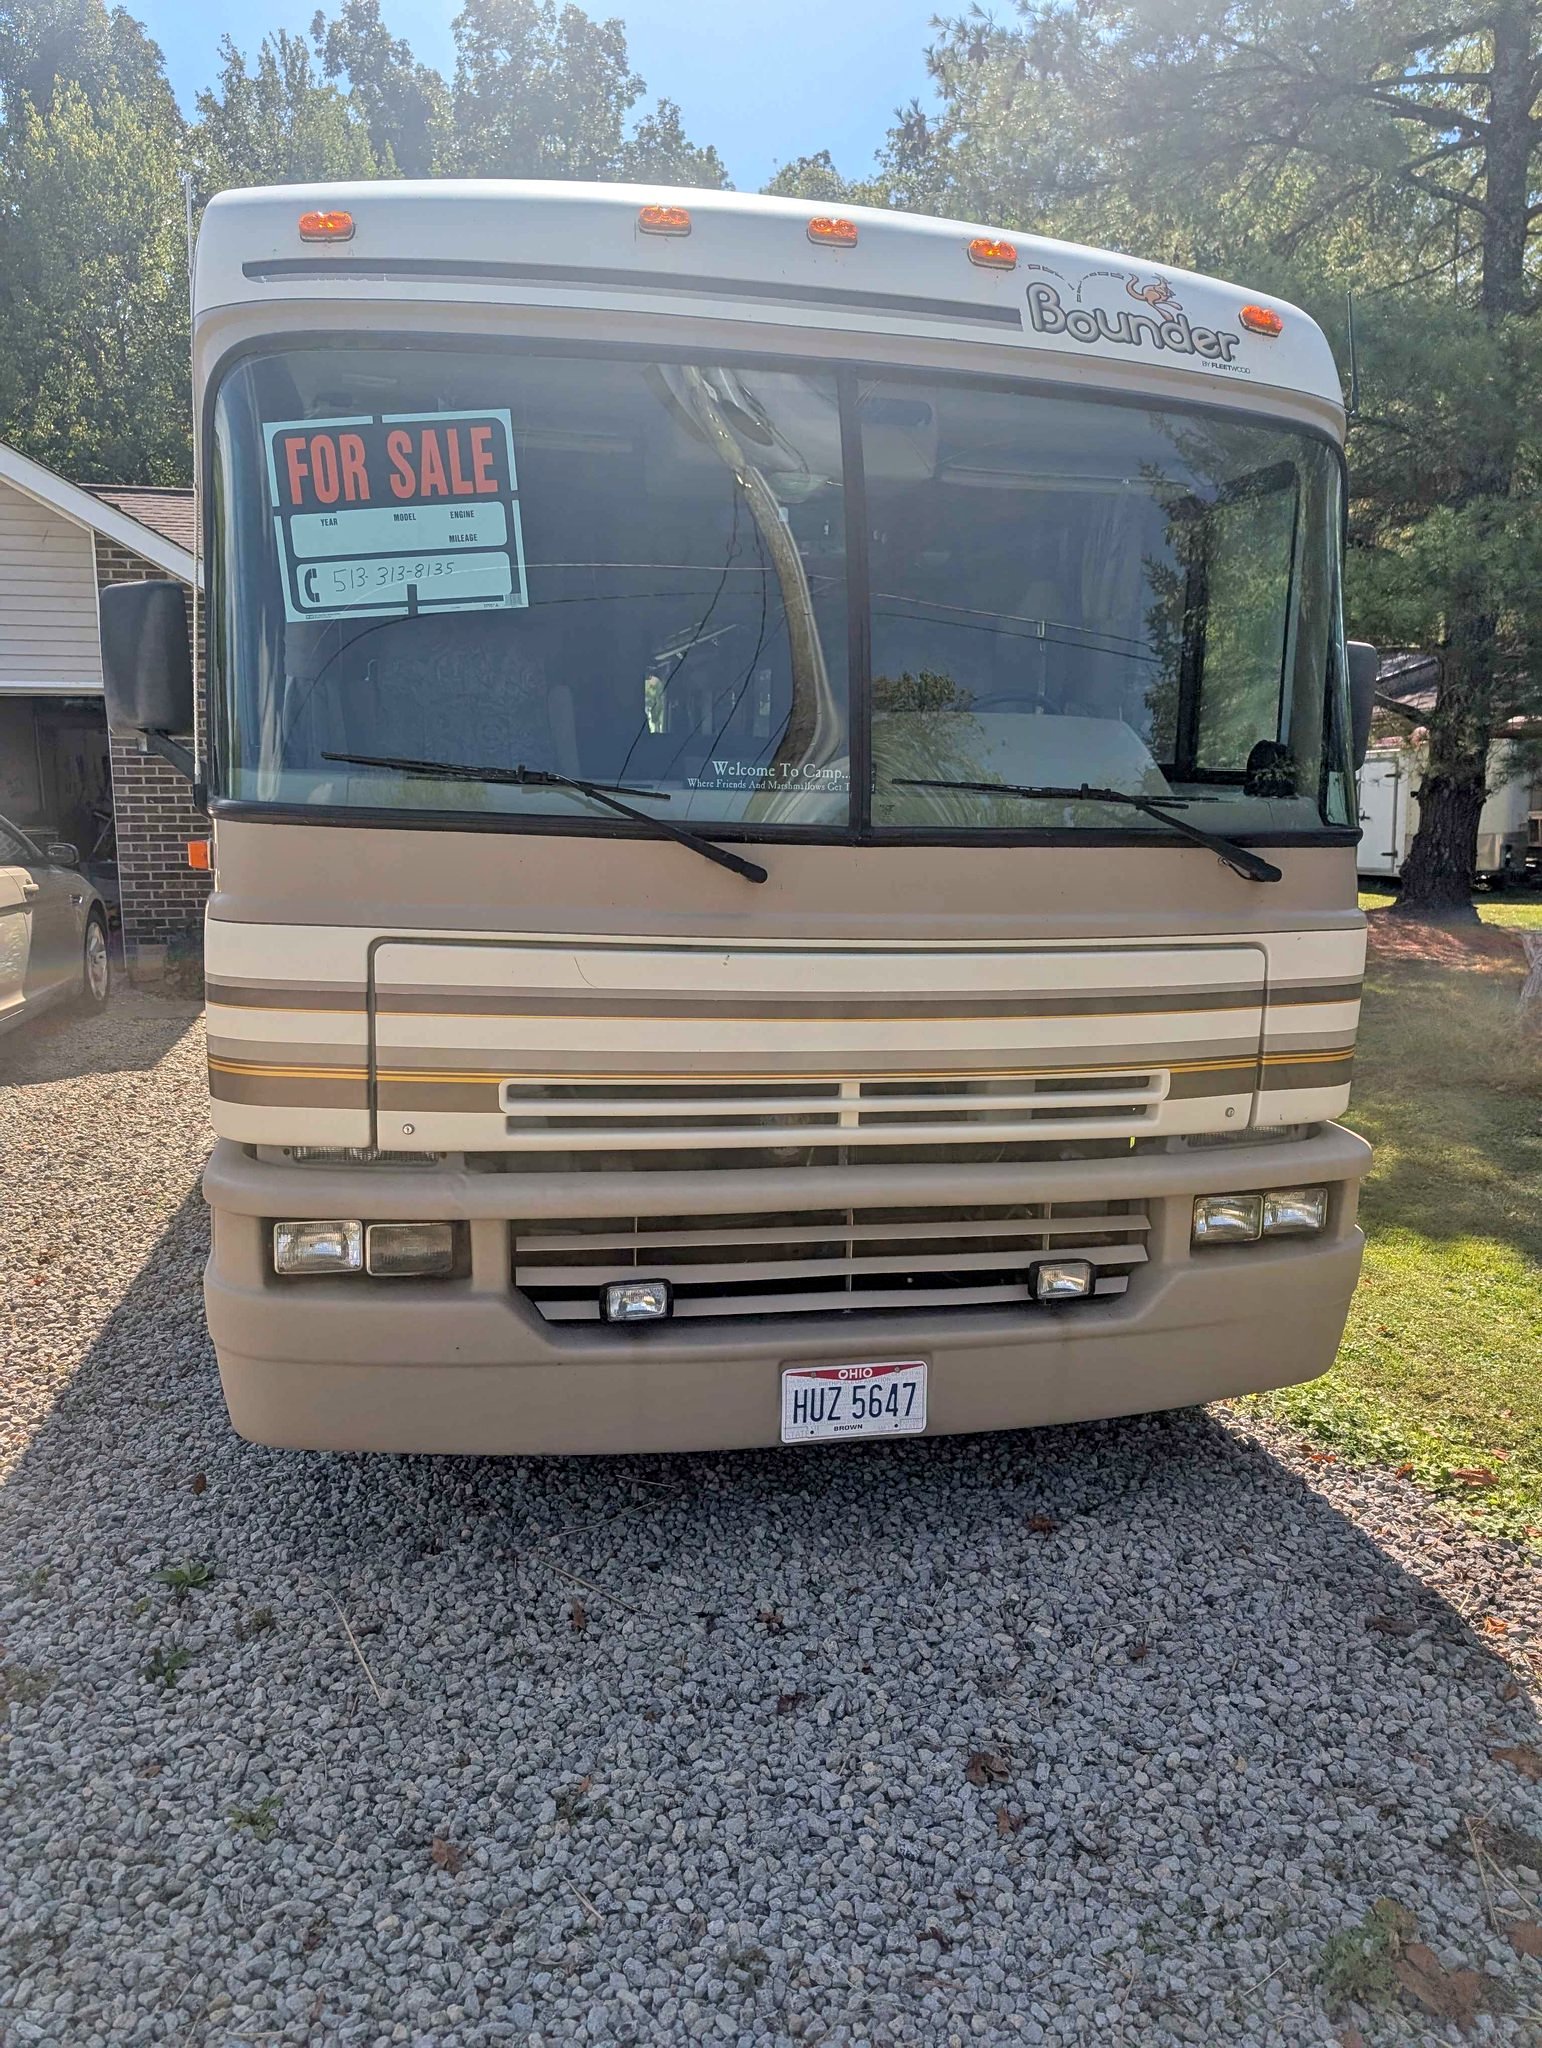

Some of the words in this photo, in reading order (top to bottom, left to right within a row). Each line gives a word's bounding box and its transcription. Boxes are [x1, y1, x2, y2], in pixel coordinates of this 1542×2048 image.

[1026, 282, 1240, 362] Bounder
[1201, 360, 1210, 368] BY
[1211, 362, 1251, 374] FLEETWOOD
[284, 433, 371, 505] FOR
[387, 426, 498, 499] SALE
[320, 517, 338, 527] YEAR
[393, 513, 417, 522] MODEL
[449, 510, 475, 519] ENGINE
[448, 533, 478, 543] MILEAGE
[712, 760, 775, 777] Welcome
[780, 763, 799, 777] To
[688, 778, 714, 788] Where
[716, 778, 747, 789] Friends
[748, 780, 766, 790] And
[768, 780, 826, 791] Marshmallows
[827, 782, 842, 791] Get
[838, 1367, 873, 1380] OHIO
[793, 1386, 842, 1424] HUZ
[852, 1382, 916, 1419] 5647
[833, 1424, 863, 1432] BROWN
